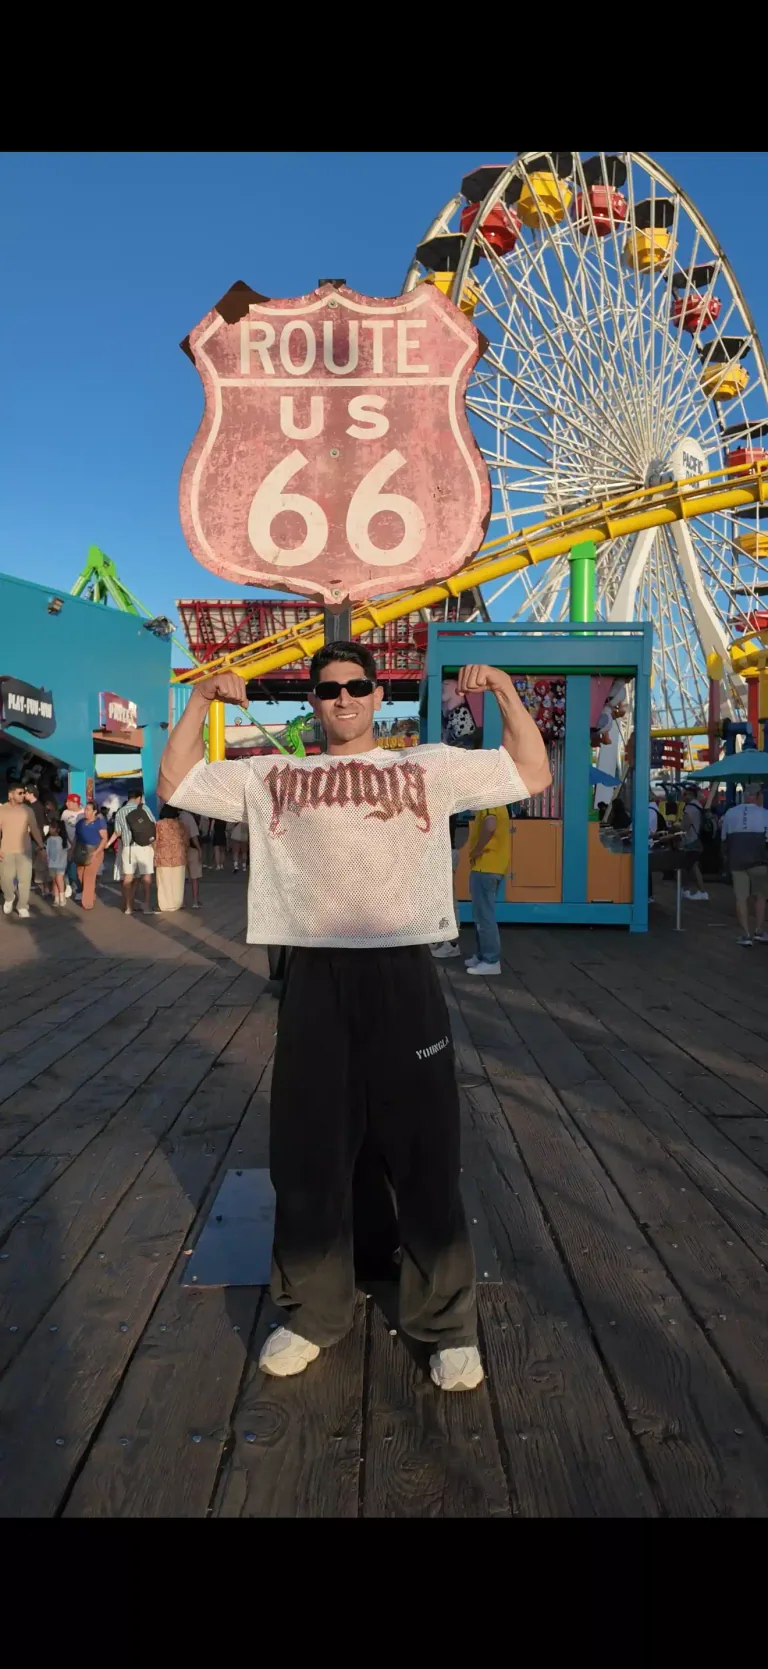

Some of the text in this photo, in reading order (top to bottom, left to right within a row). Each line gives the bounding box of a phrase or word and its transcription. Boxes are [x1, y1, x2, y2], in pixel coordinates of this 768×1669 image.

[239, 319, 430, 376] ROUTE
[682, 451, 704, 476] PACIFIC
[247, 448, 427, 567] 66
